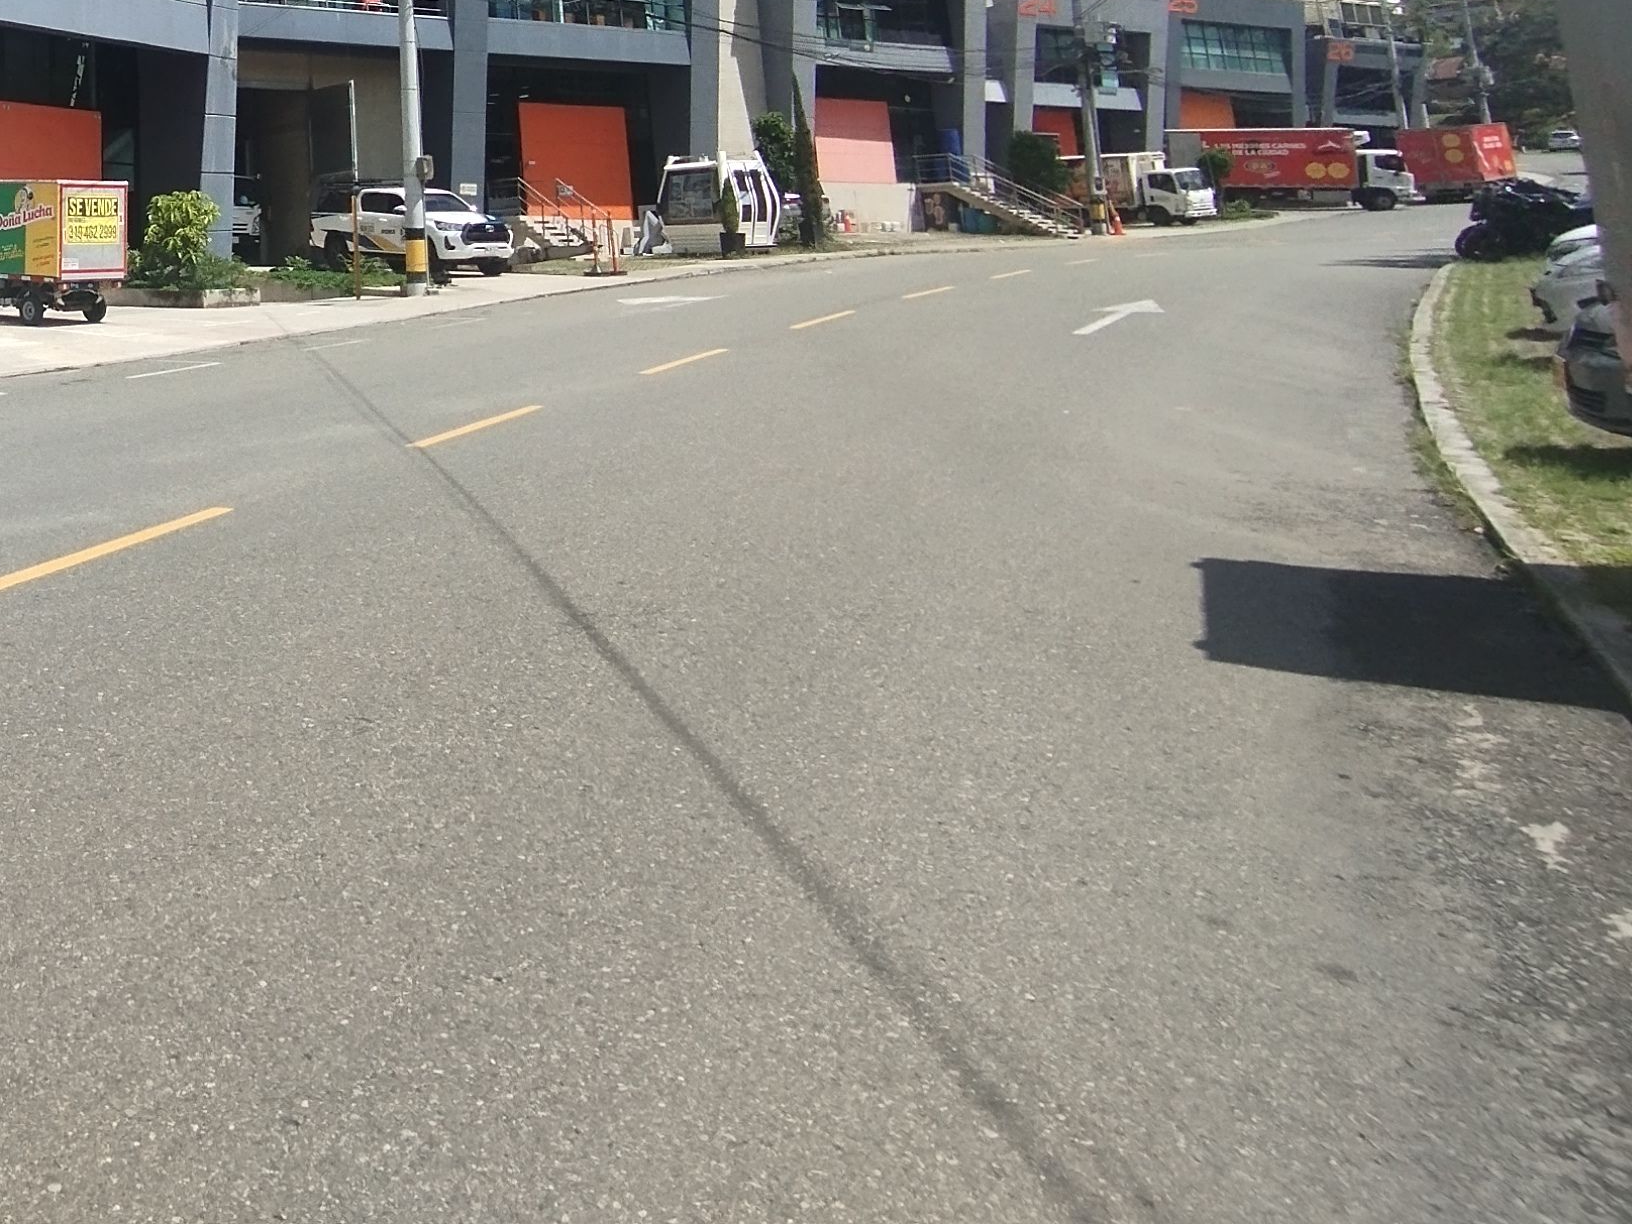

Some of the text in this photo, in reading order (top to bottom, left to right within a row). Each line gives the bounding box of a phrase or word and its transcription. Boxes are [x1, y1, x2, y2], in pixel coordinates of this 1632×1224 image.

[1327, 42, 1354, 62] 26
[22, 204, 54, 223] Lucha
[69, 197, 118, 216] SE VENDE
